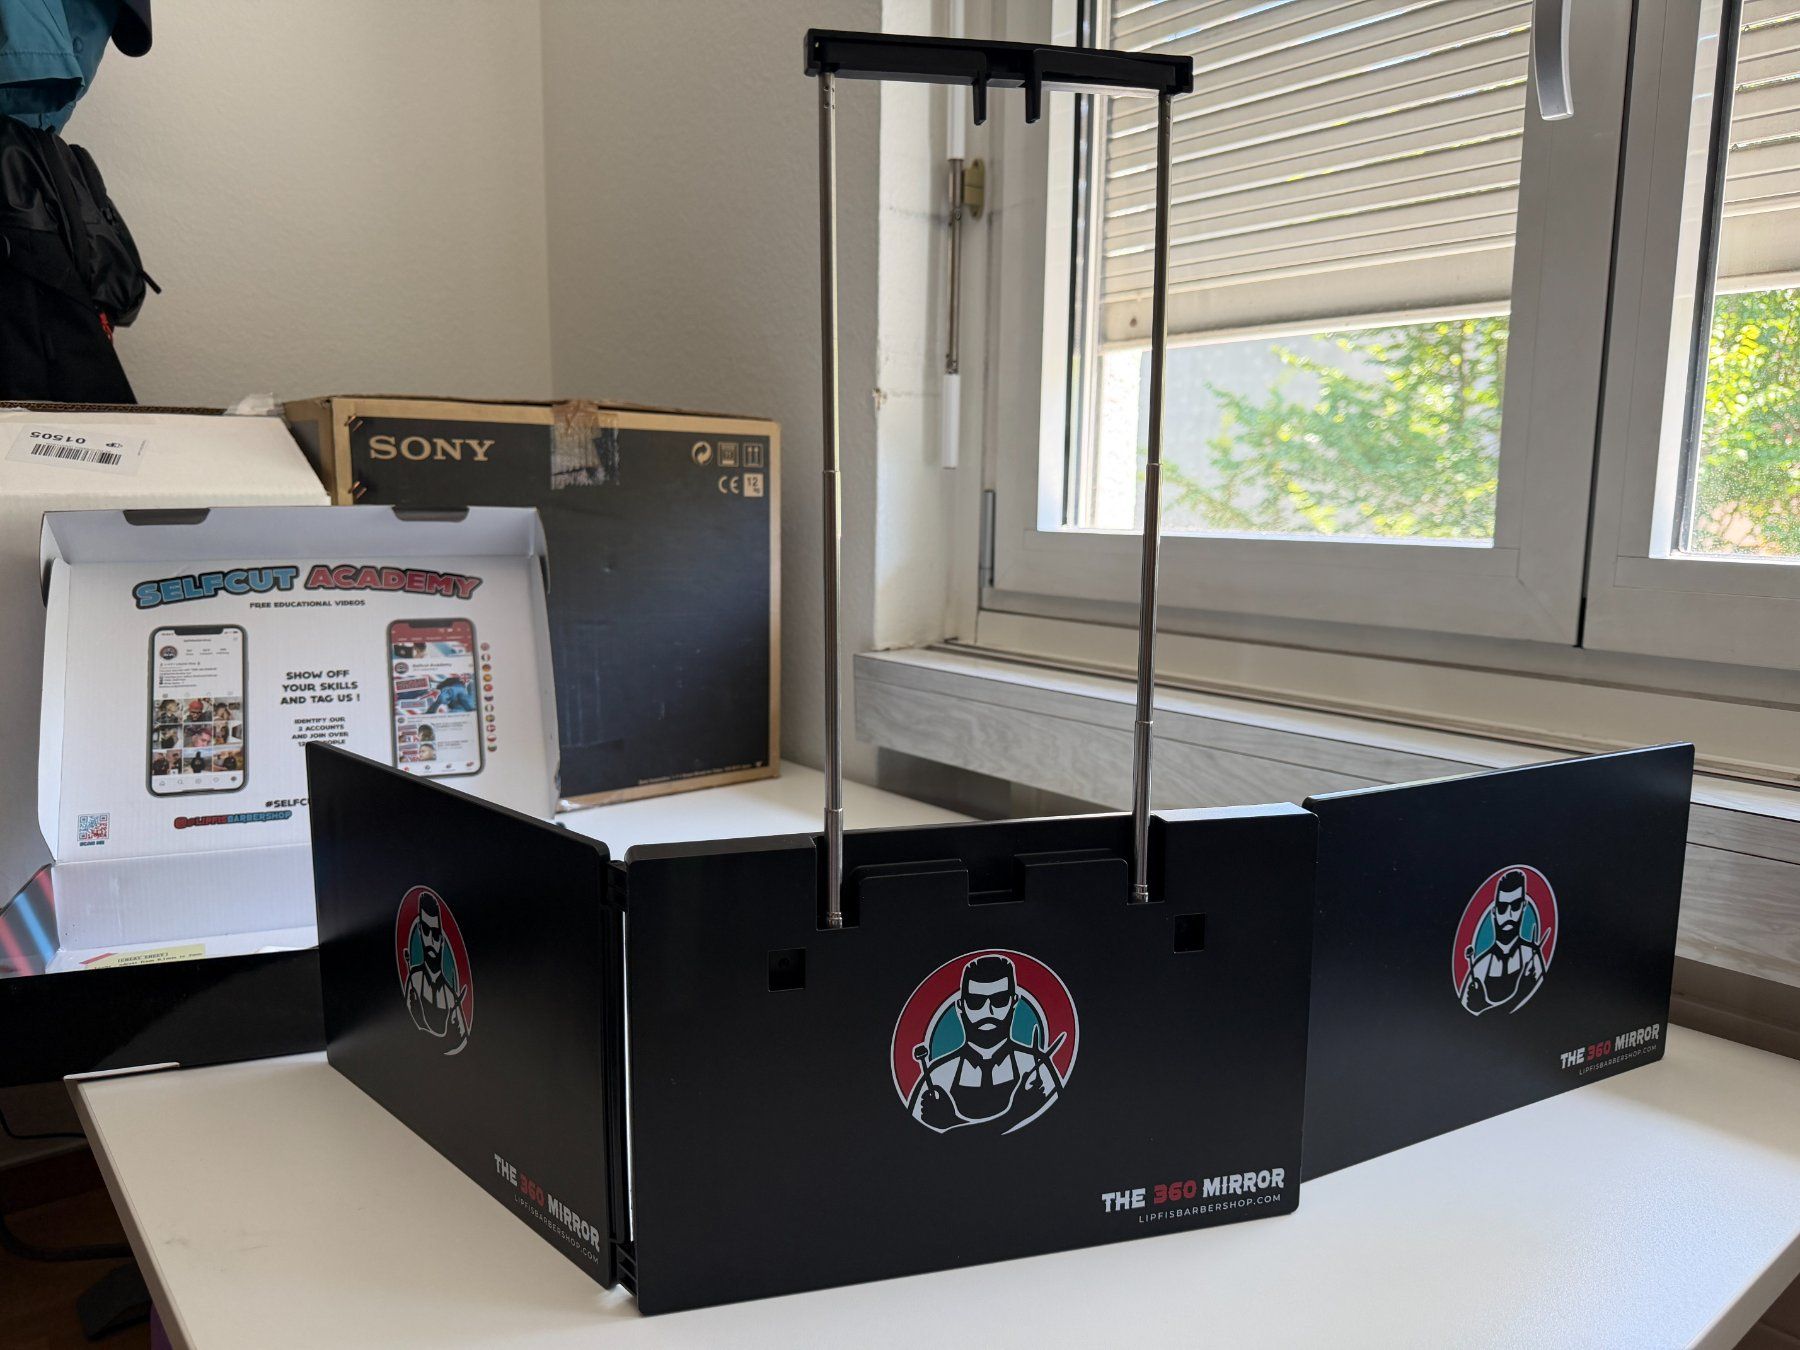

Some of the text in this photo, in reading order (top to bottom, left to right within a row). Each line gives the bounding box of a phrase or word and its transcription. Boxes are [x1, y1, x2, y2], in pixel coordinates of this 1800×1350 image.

[30, 431, 86, 445] 01505
[369, 435, 495, 461] SONY
[132, 564, 483, 609] SELFCUT ACADEMY
[249, 601, 271, 609] FREE
[274, 600, 332, 608] EDUCATIONAL
[282, 681, 358, 693] YOUR SKILLS
[286, 669, 350, 681] SHOW OFF
[280, 695, 307, 705] AND
[310, 694, 333, 704] TAG
[337, 693, 353, 702] US
[265, 798, 310, 808] #SELFC
[1560, 1023, 1660, 1070] THE 360 MIRROR
[1578, 1044, 1657, 1076] LIPFISBARBERSHOP.COM
[494, 1153, 600, 1253] THE 360 MIRROR
[1101, 1167, 1285, 1213] THE 360 MIRROR
[1139, 1194, 1281, 1223] LIPFISBARBERSHOP.COM
